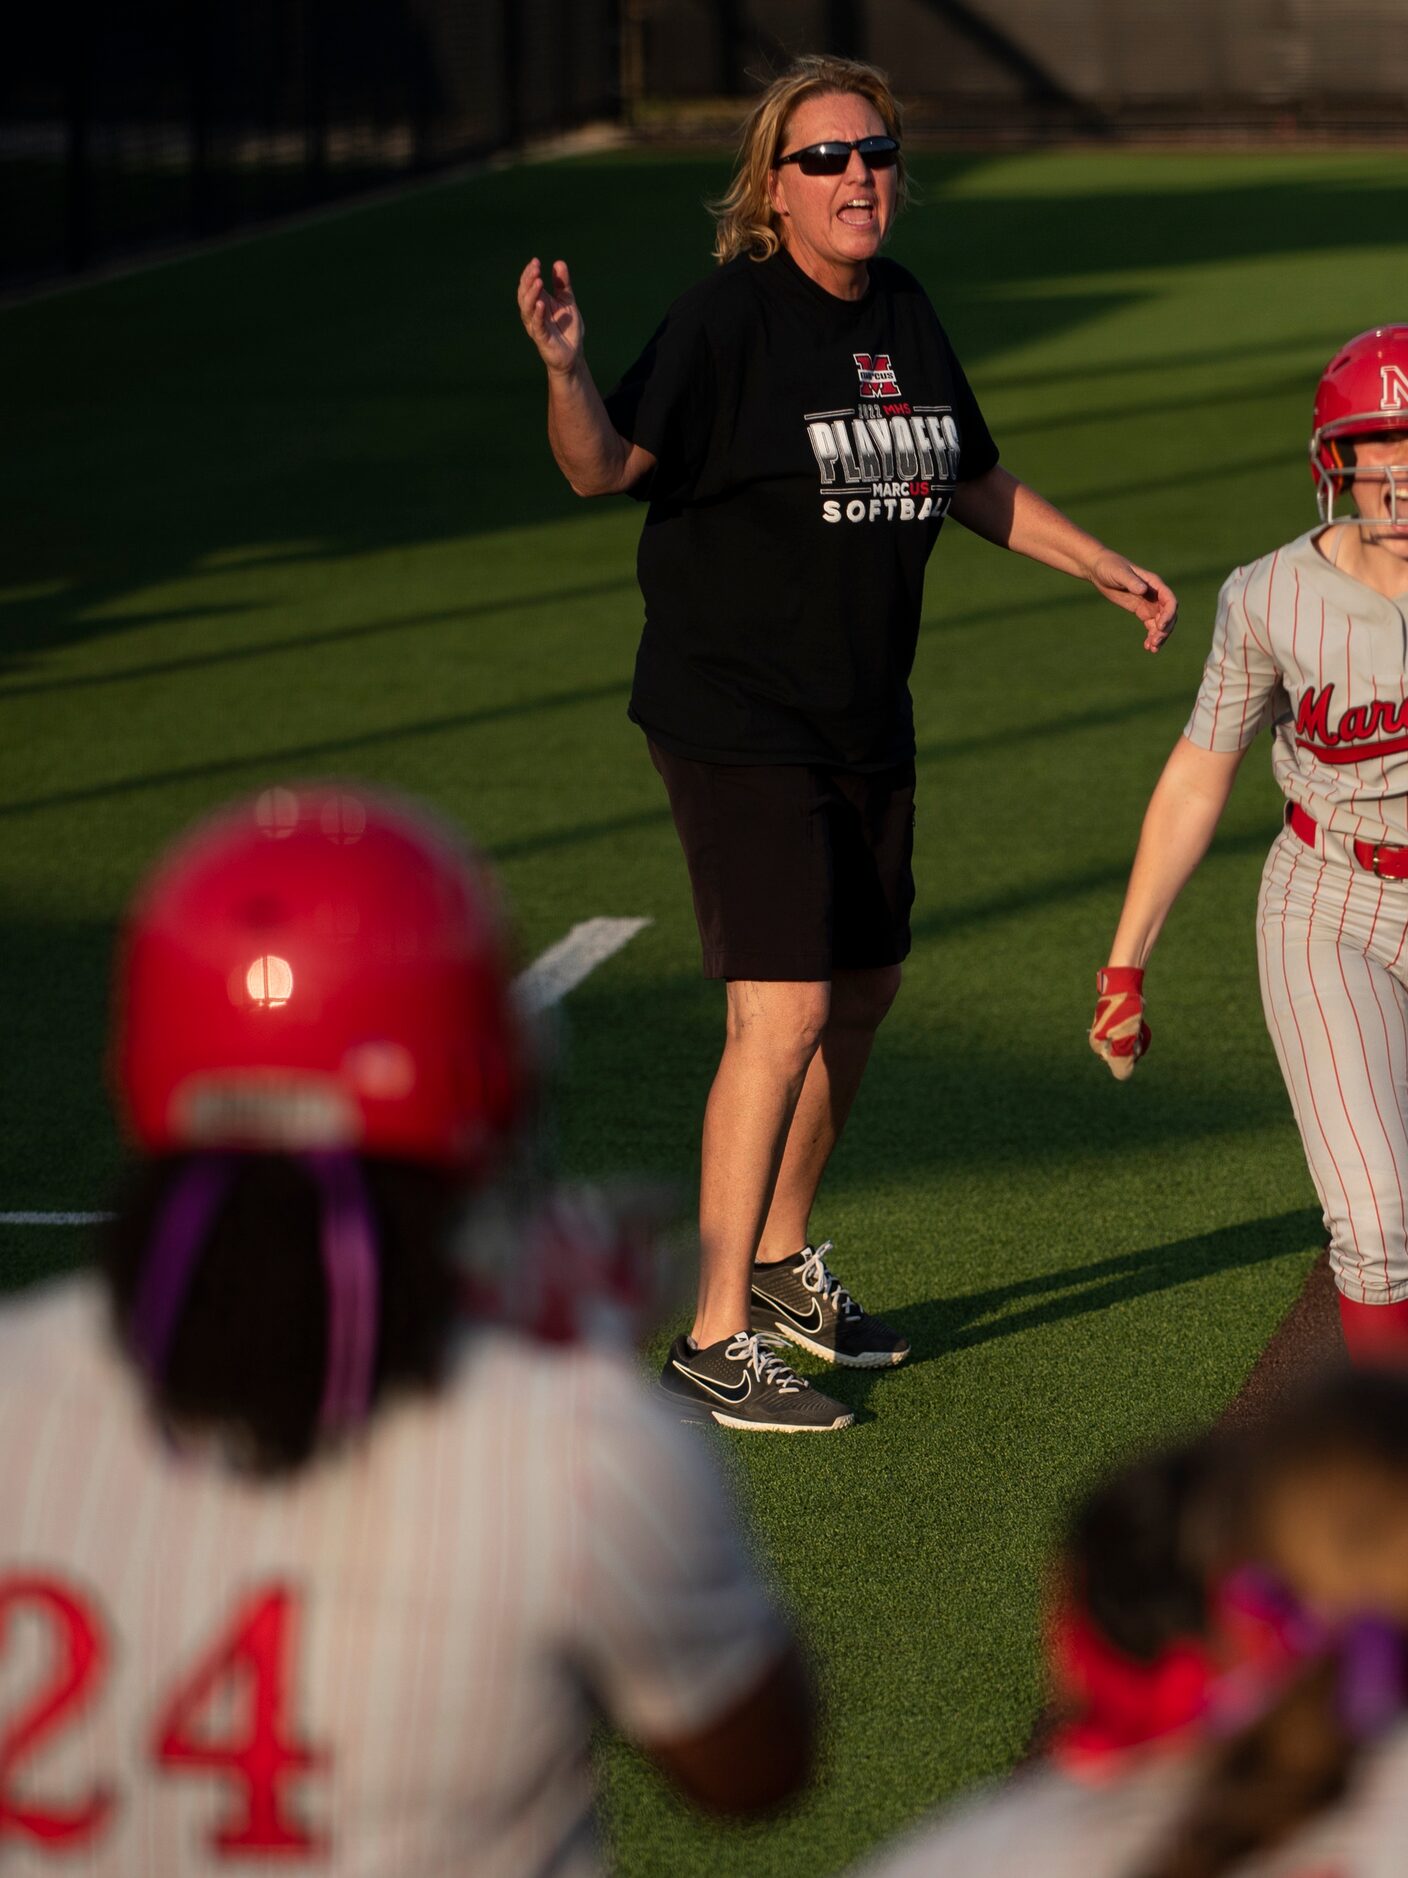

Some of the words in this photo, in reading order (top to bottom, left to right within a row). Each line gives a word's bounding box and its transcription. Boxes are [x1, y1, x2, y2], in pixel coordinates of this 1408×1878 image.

[853, 353, 901, 398] M
[882, 402, 911, 416] MHS
[807, 415, 960, 484] PLAYOFFS
[872, 481, 929, 497] MARCUS
[0, 1568, 333, 1866] 24
